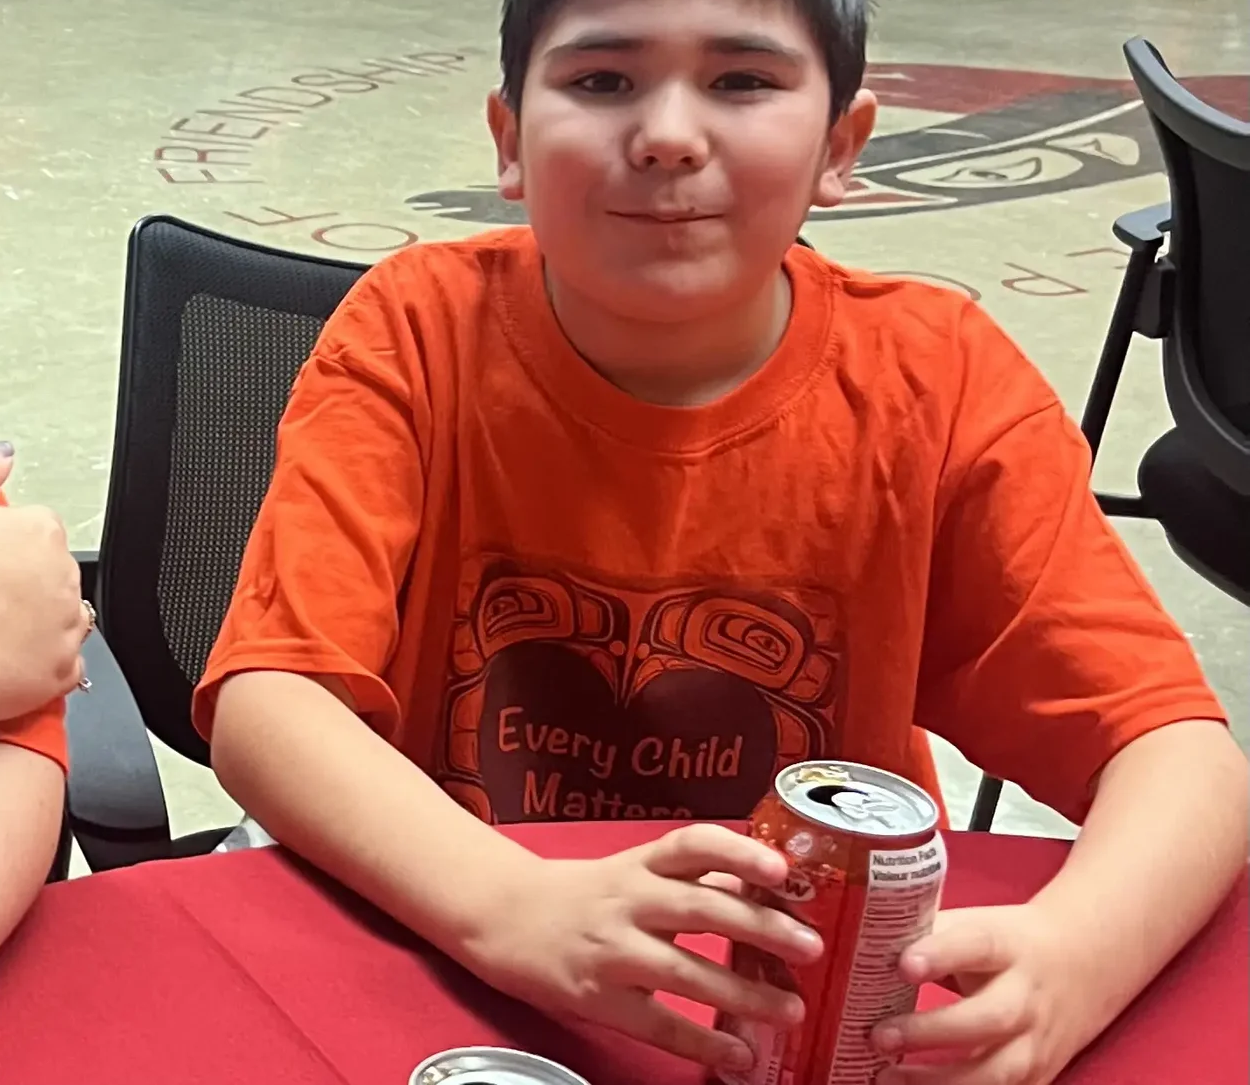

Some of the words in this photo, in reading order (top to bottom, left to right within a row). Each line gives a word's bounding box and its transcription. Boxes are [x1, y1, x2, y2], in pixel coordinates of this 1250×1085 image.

[153, 50, 469, 185] FRIENDSHIP
[498, 706, 618, 780] Every
[631, 734, 744, 779] Child
